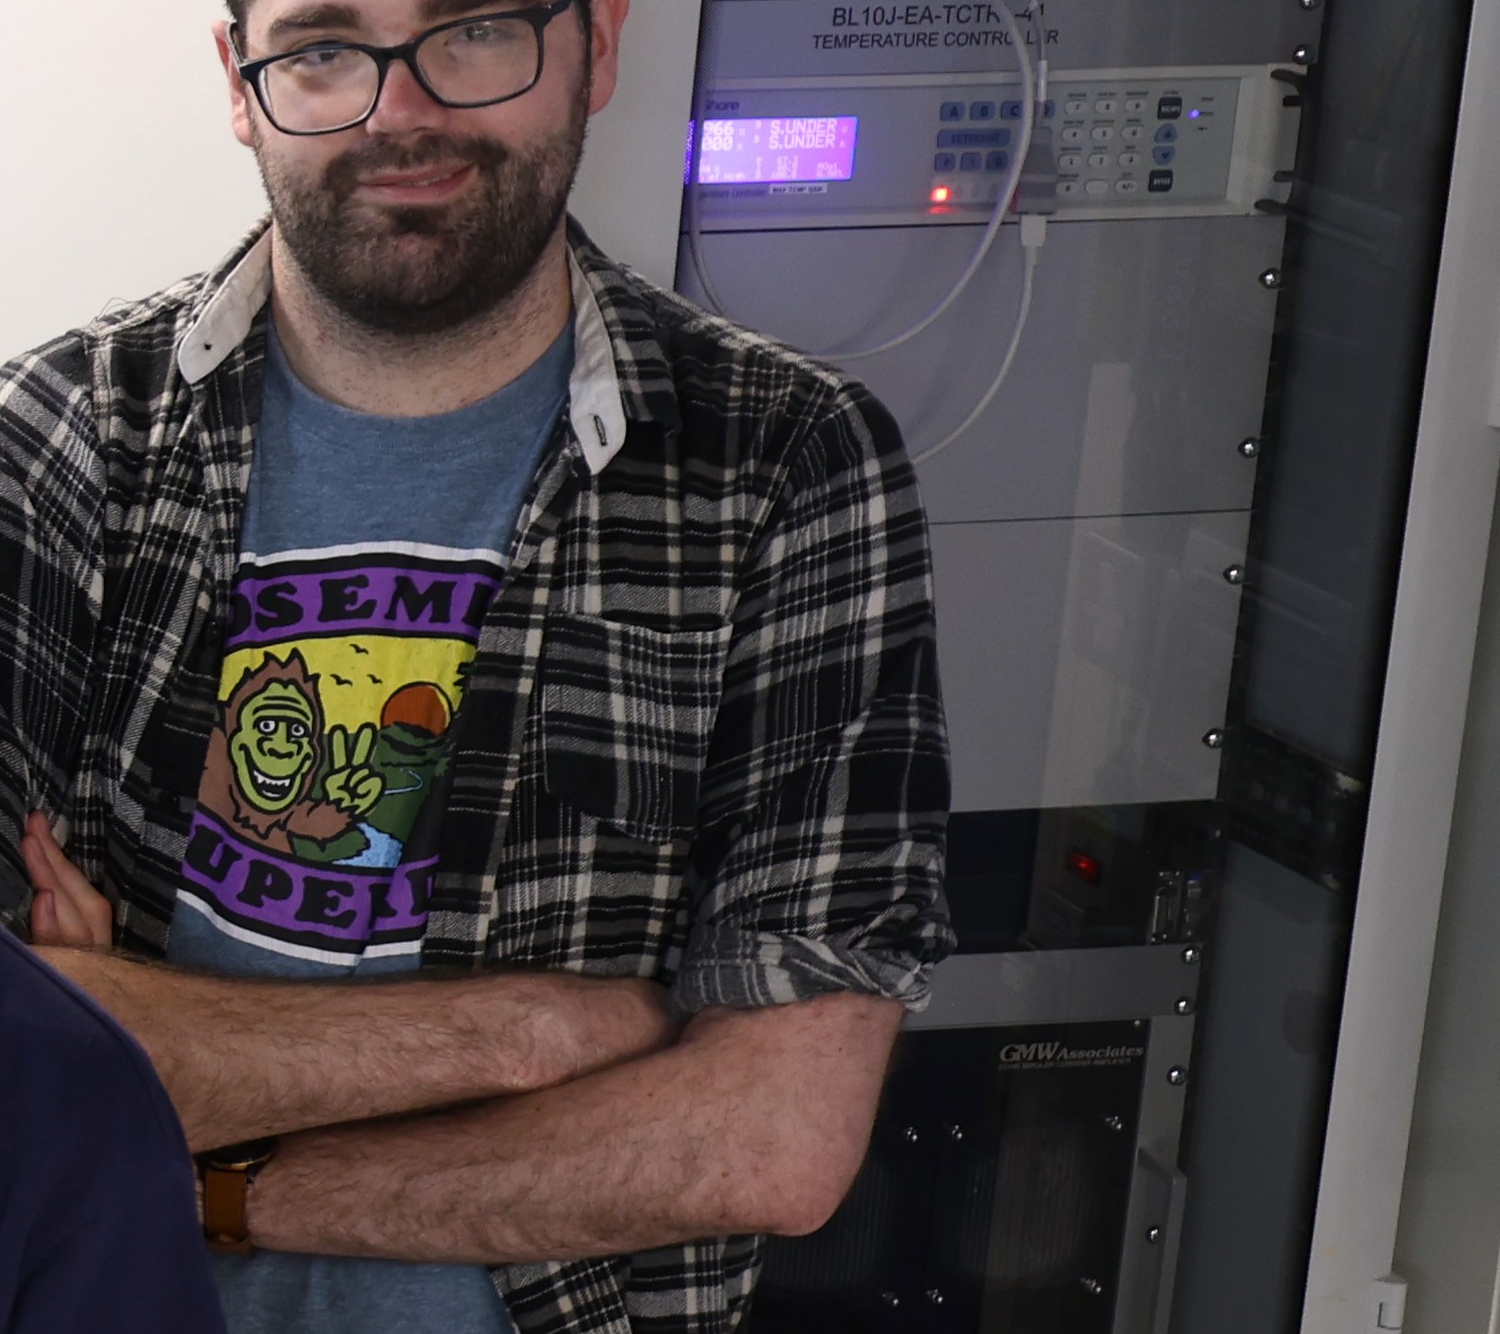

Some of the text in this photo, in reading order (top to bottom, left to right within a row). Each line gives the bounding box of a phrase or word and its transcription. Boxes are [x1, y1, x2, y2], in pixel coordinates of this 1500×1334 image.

[832, 3, 1045, 27] BL10J-EA-TCTR-41
[813, 30, 1060, 50] TEMPERATURE CONTROLR
[999, 1041, 1144, 1062] GMW Associates
